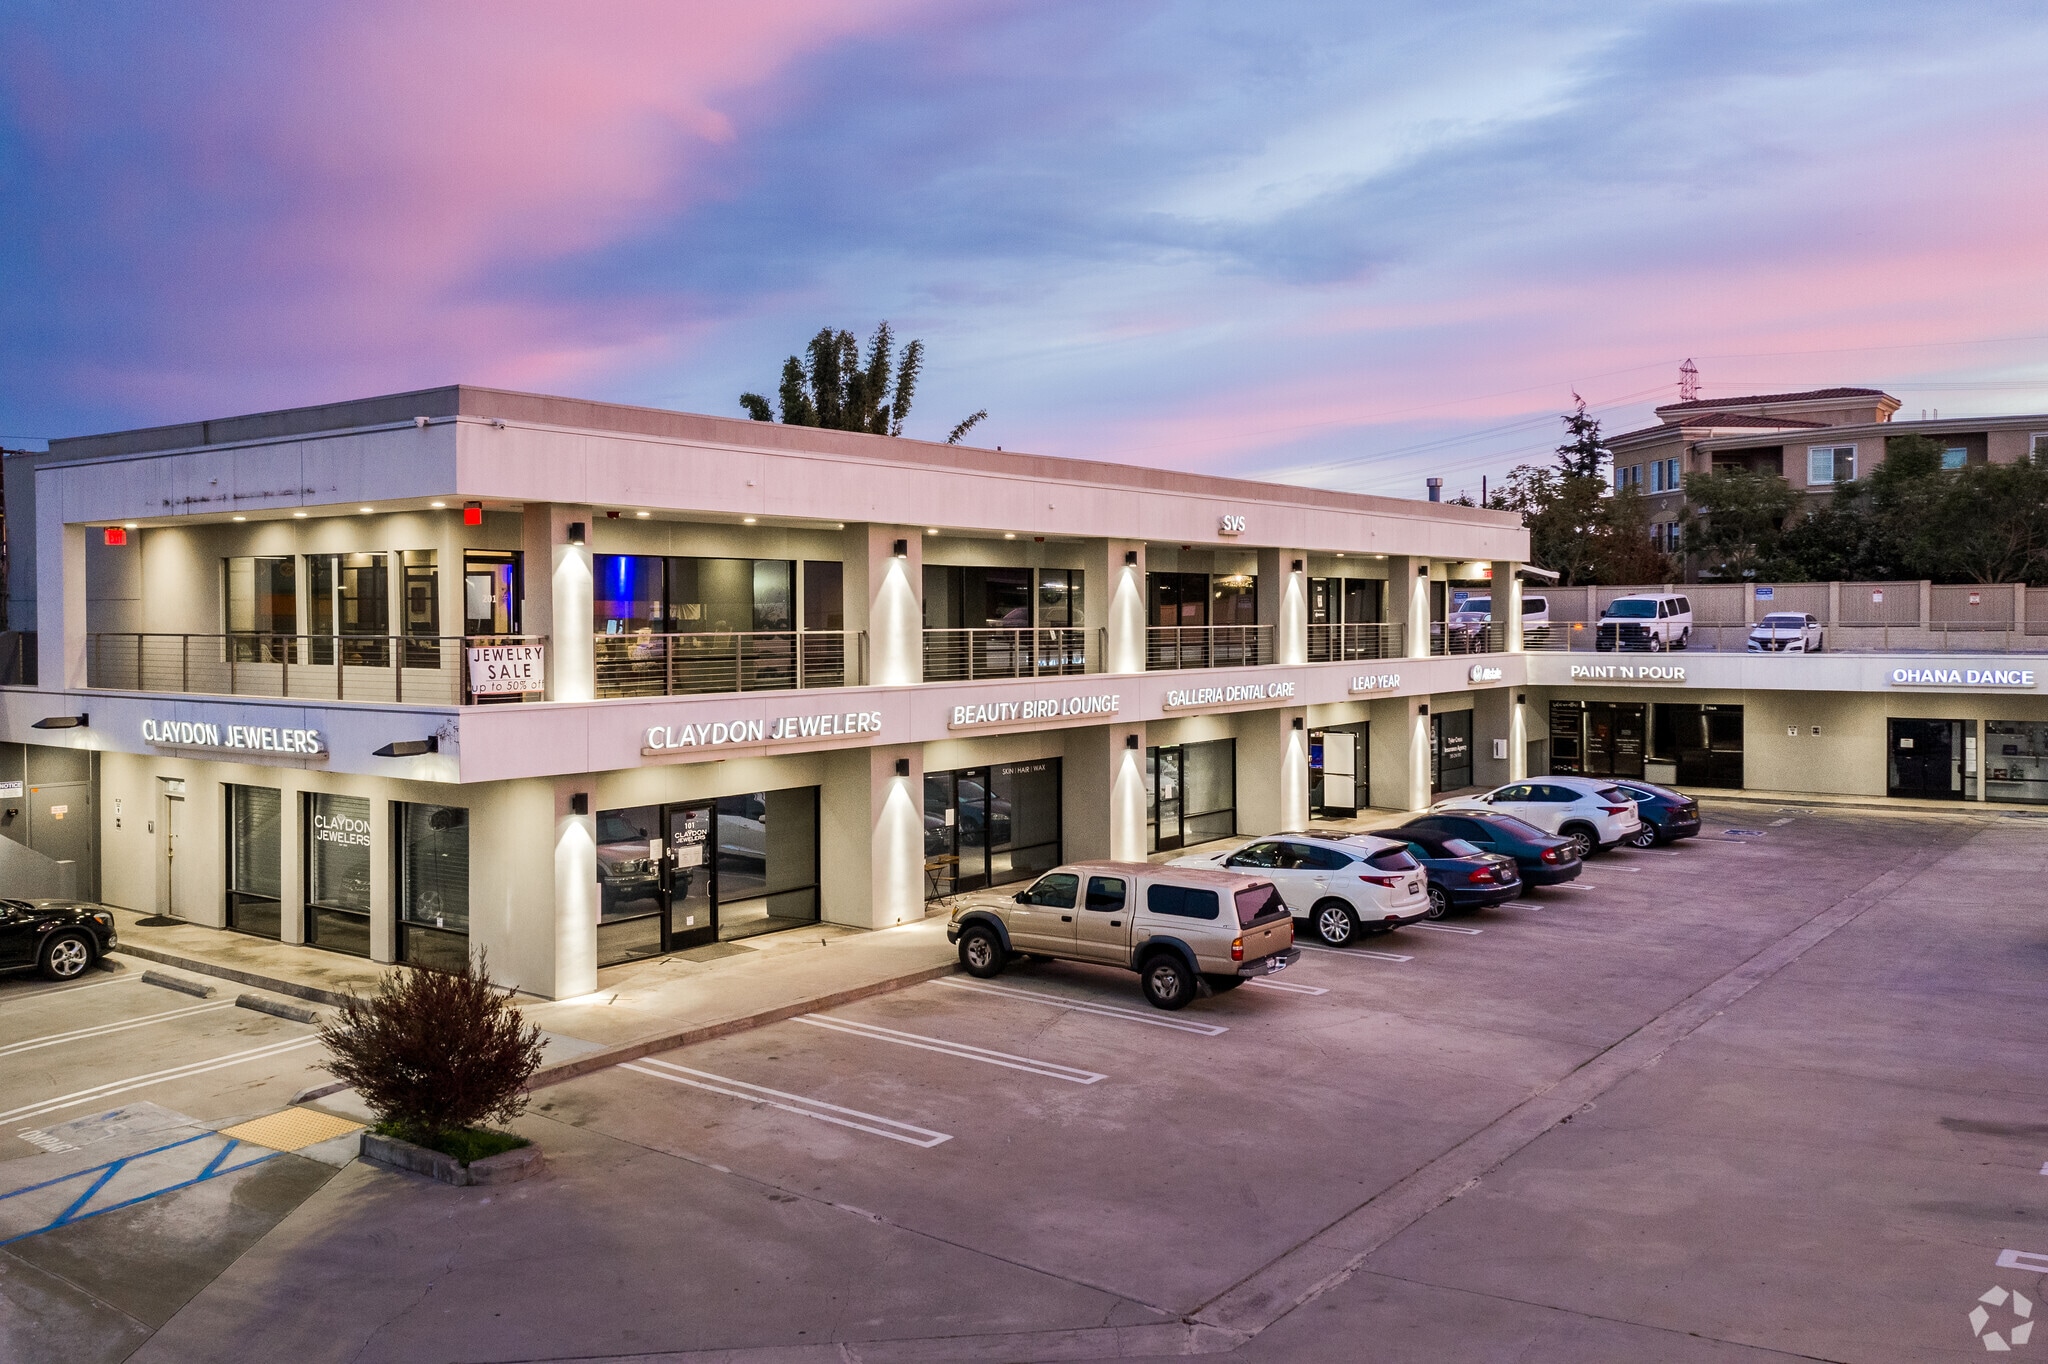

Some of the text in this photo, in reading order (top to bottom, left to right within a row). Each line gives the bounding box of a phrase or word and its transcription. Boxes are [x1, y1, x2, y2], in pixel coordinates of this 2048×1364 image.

[1224, 514, 1246, 531] SVS
[474, 647, 542, 662] JEWELRY
[488, 664, 531, 679] SALE
[1571, 665, 1616, 678] PAINT
[1639, 666, 1685, 679] POUR
[1892, 669, 2035, 685] OHANA DANCE
[472, 683, 486, 693] up
[492, 682, 502, 691] to
[507, 680, 527, 691] 50%
[1353, 674, 1400, 690] LEAP YEAR
[1168, 682, 1295, 706] GALLERIA DENTAL CARE
[954, 694, 1120, 725] BEAUTY BIRD LOUNGE
[142, 719, 319, 754] CLAYDON JEWELERS
[648, 711, 882, 749] CLAYDON JEWELERS
[1017, 766, 1029, 774] HAIR
[317, 830, 370, 846] JEWELERS
[674, 829, 708, 839] CLAYDON
